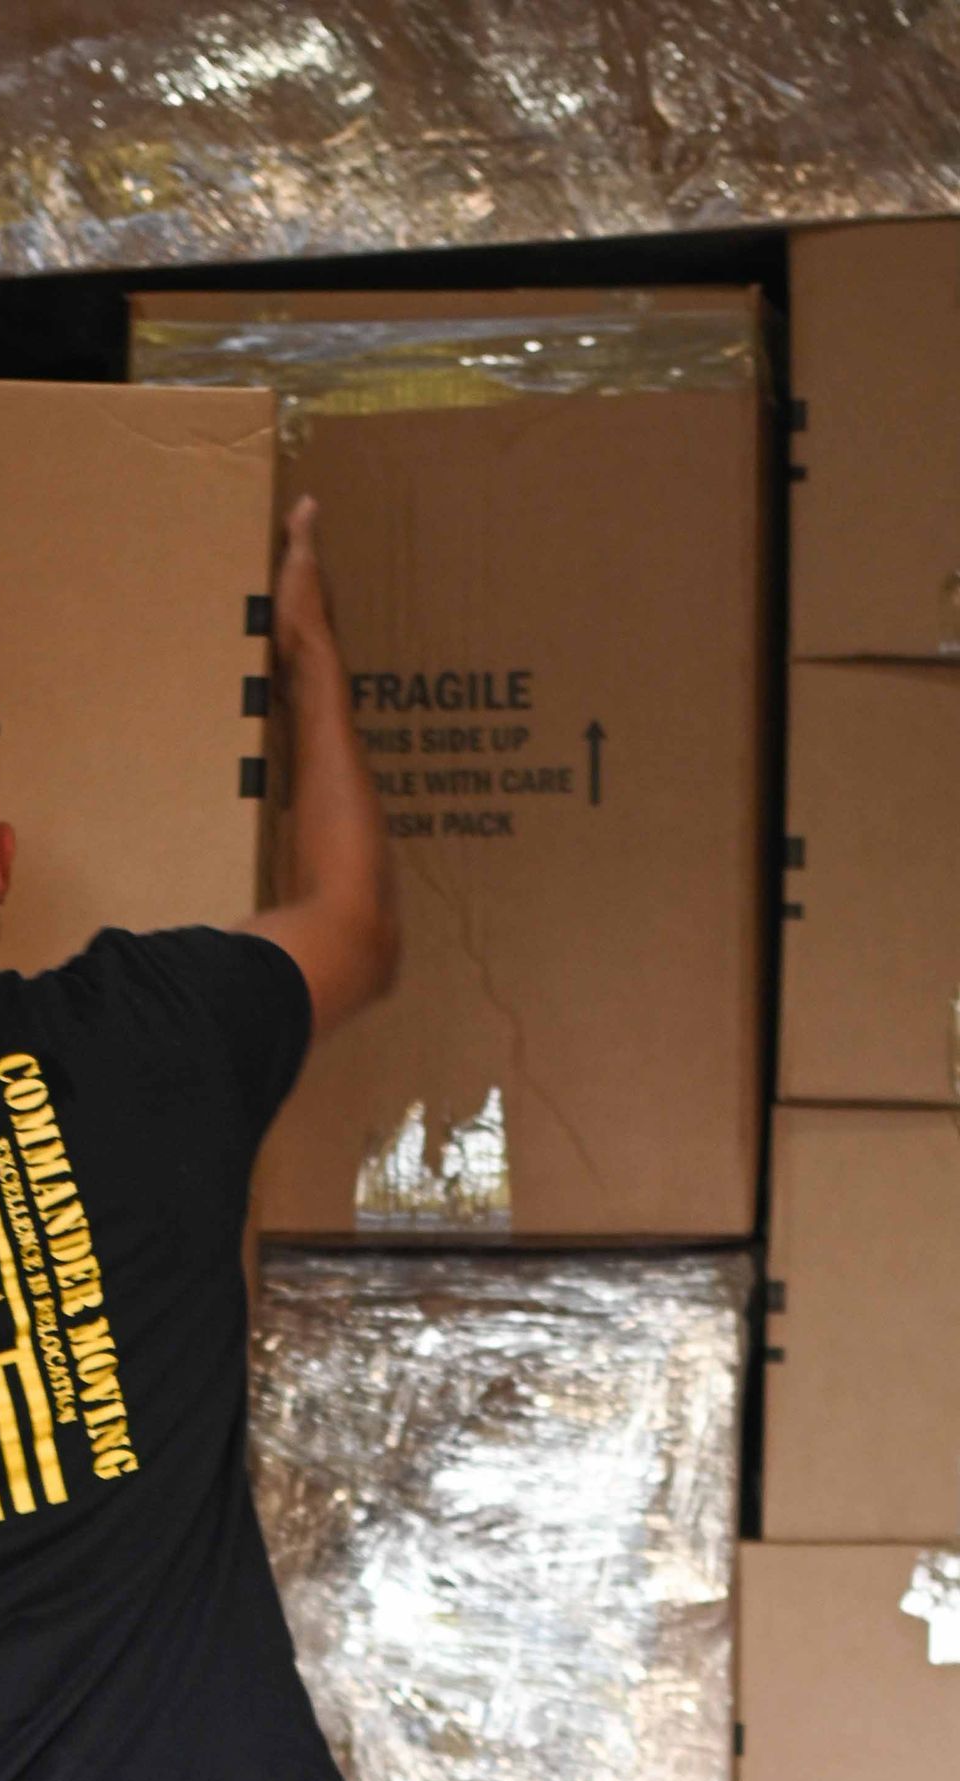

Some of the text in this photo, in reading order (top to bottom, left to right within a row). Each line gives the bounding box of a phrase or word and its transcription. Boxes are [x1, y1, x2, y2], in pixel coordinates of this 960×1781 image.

[351, 671, 533, 711] FRAGILE
[421, 726, 484, 753] SIDE
[491, 725, 530, 751] UP
[424, 769, 492, 795] WITH
[500, 767, 575, 794] CARE
[386, 810, 515, 838] ISH PACK
[26, 1271, 53, 1297] IN
[33, 1296, 79, 1424] RELOCATION
[66, 1315, 140, 1481] MOVING
